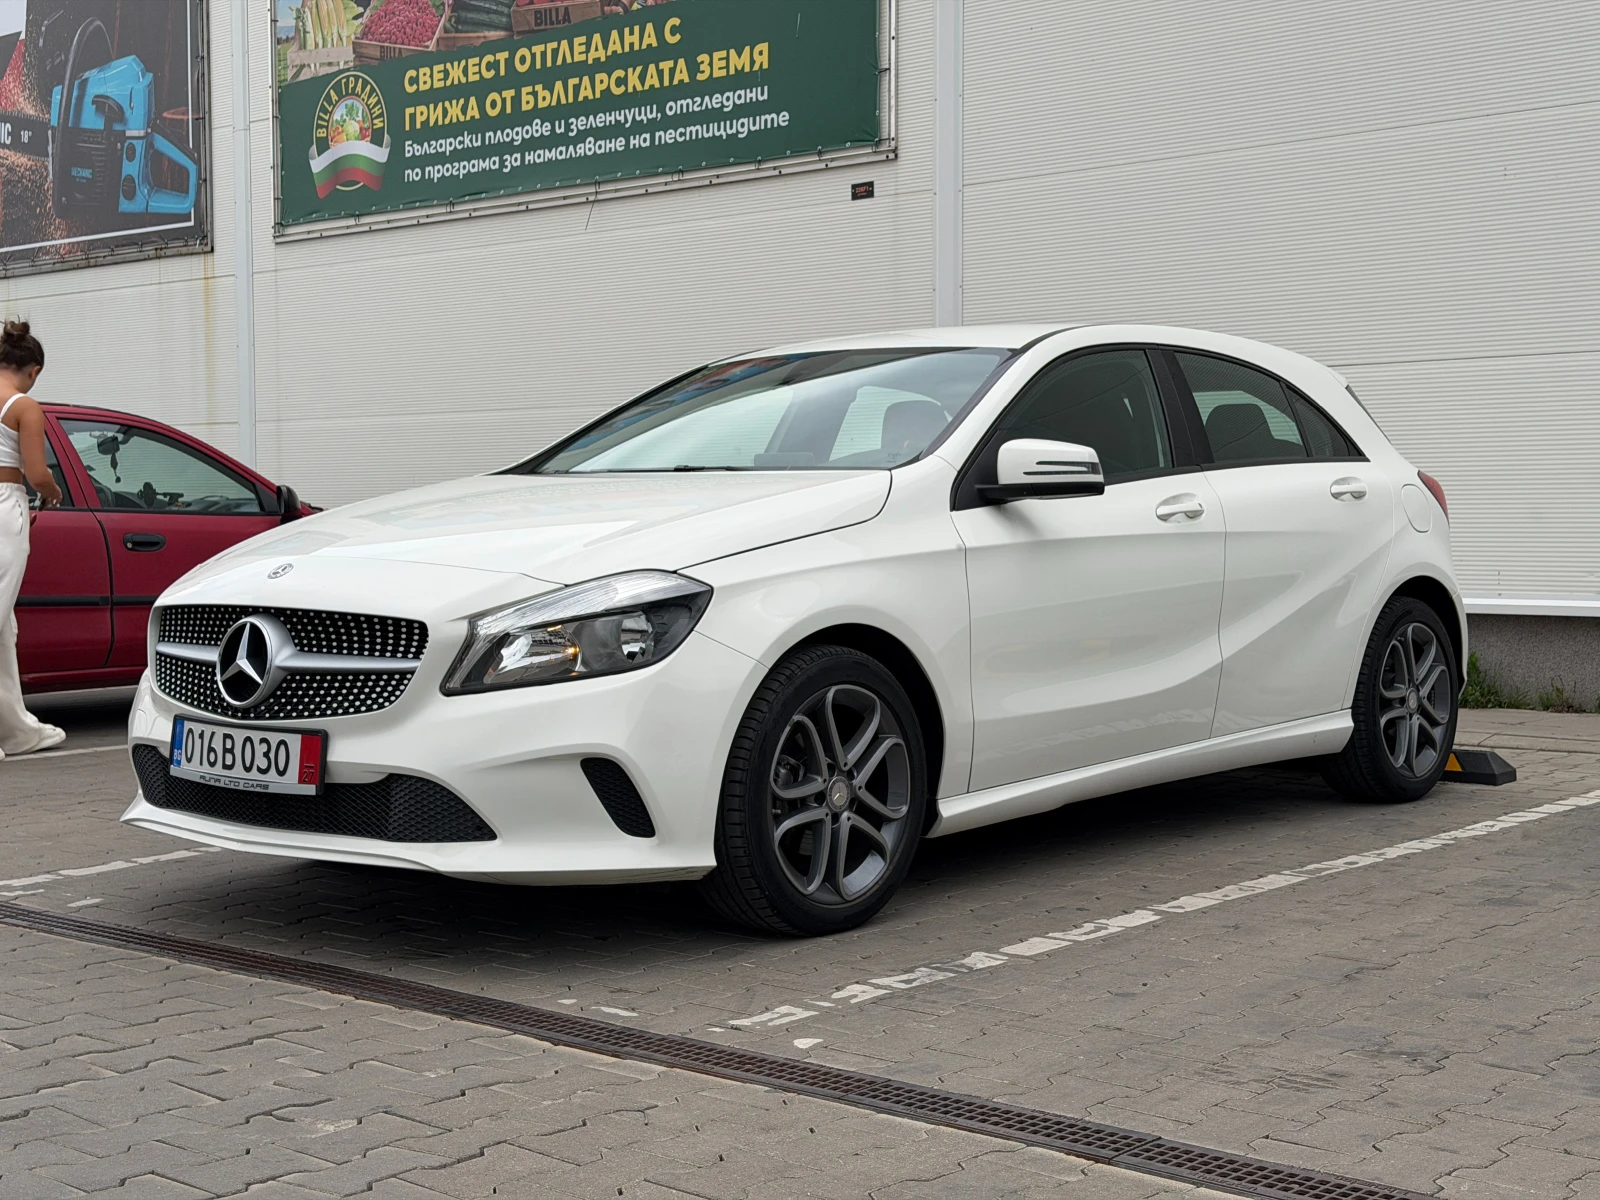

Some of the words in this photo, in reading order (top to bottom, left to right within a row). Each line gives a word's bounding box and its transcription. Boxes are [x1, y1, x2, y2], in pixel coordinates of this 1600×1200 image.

[534, 7, 572, 27] BILLA
[404, 52, 509, 94] СВЕЖЕСТ
[514, 22, 658, 73] ОТГЛЕДАНА
[664, 17, 682, 44] С
[317, 88, 339, 138] BILLA
[341, 77, 384, 130] ГРАДИНИ
[405, 96, 480, 131] ГРИЖА
[485, 88, 516, 117] ОТ
[521, 58, 690, 112] БЪЛГАРСКАТА
[696, 42, 769, 81] ЗЕМЯ
[0, 122, 12, 145] IC
[405, 131, 482, 157] Български
[485, 118, 551, 145] плодове
[555, 119, 565, 134] и
[568, 103, 661, 136] зеленчуци,
[665, 85, 769, 116] отгледани
[405, 168, 422, 182] по
[425, 155, 500, 182] програма
[503, 152, 521, 173] за
[525, 136, 626, 165] намаляване
[629, 132, 651, 149] на
[655, 110, 790, 145] пестицидите
[173, 749, 182, 761] BG
[223, 780, 240, 788] LTD
[242, 782, 270, 791] CARS
[302, 770, 315, 783] 27
